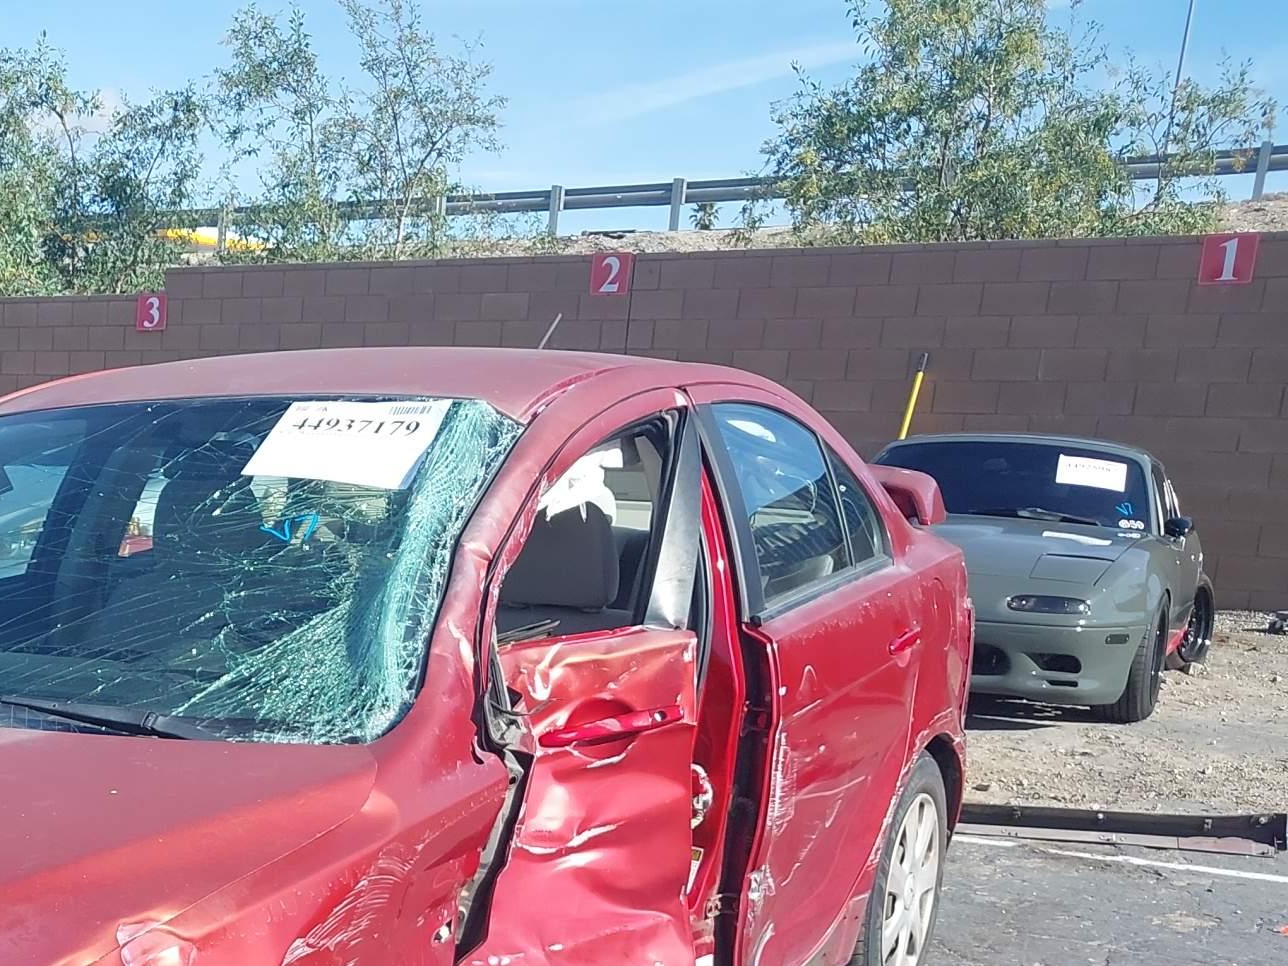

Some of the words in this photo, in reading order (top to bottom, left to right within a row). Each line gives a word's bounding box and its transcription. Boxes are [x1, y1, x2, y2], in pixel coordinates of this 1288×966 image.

[598, 256, 621, 292] 2
[1213, 237, 1239, 281] 1
[143, 296, 160, 327] 3
[292, 417, 420, 436] 44937179
